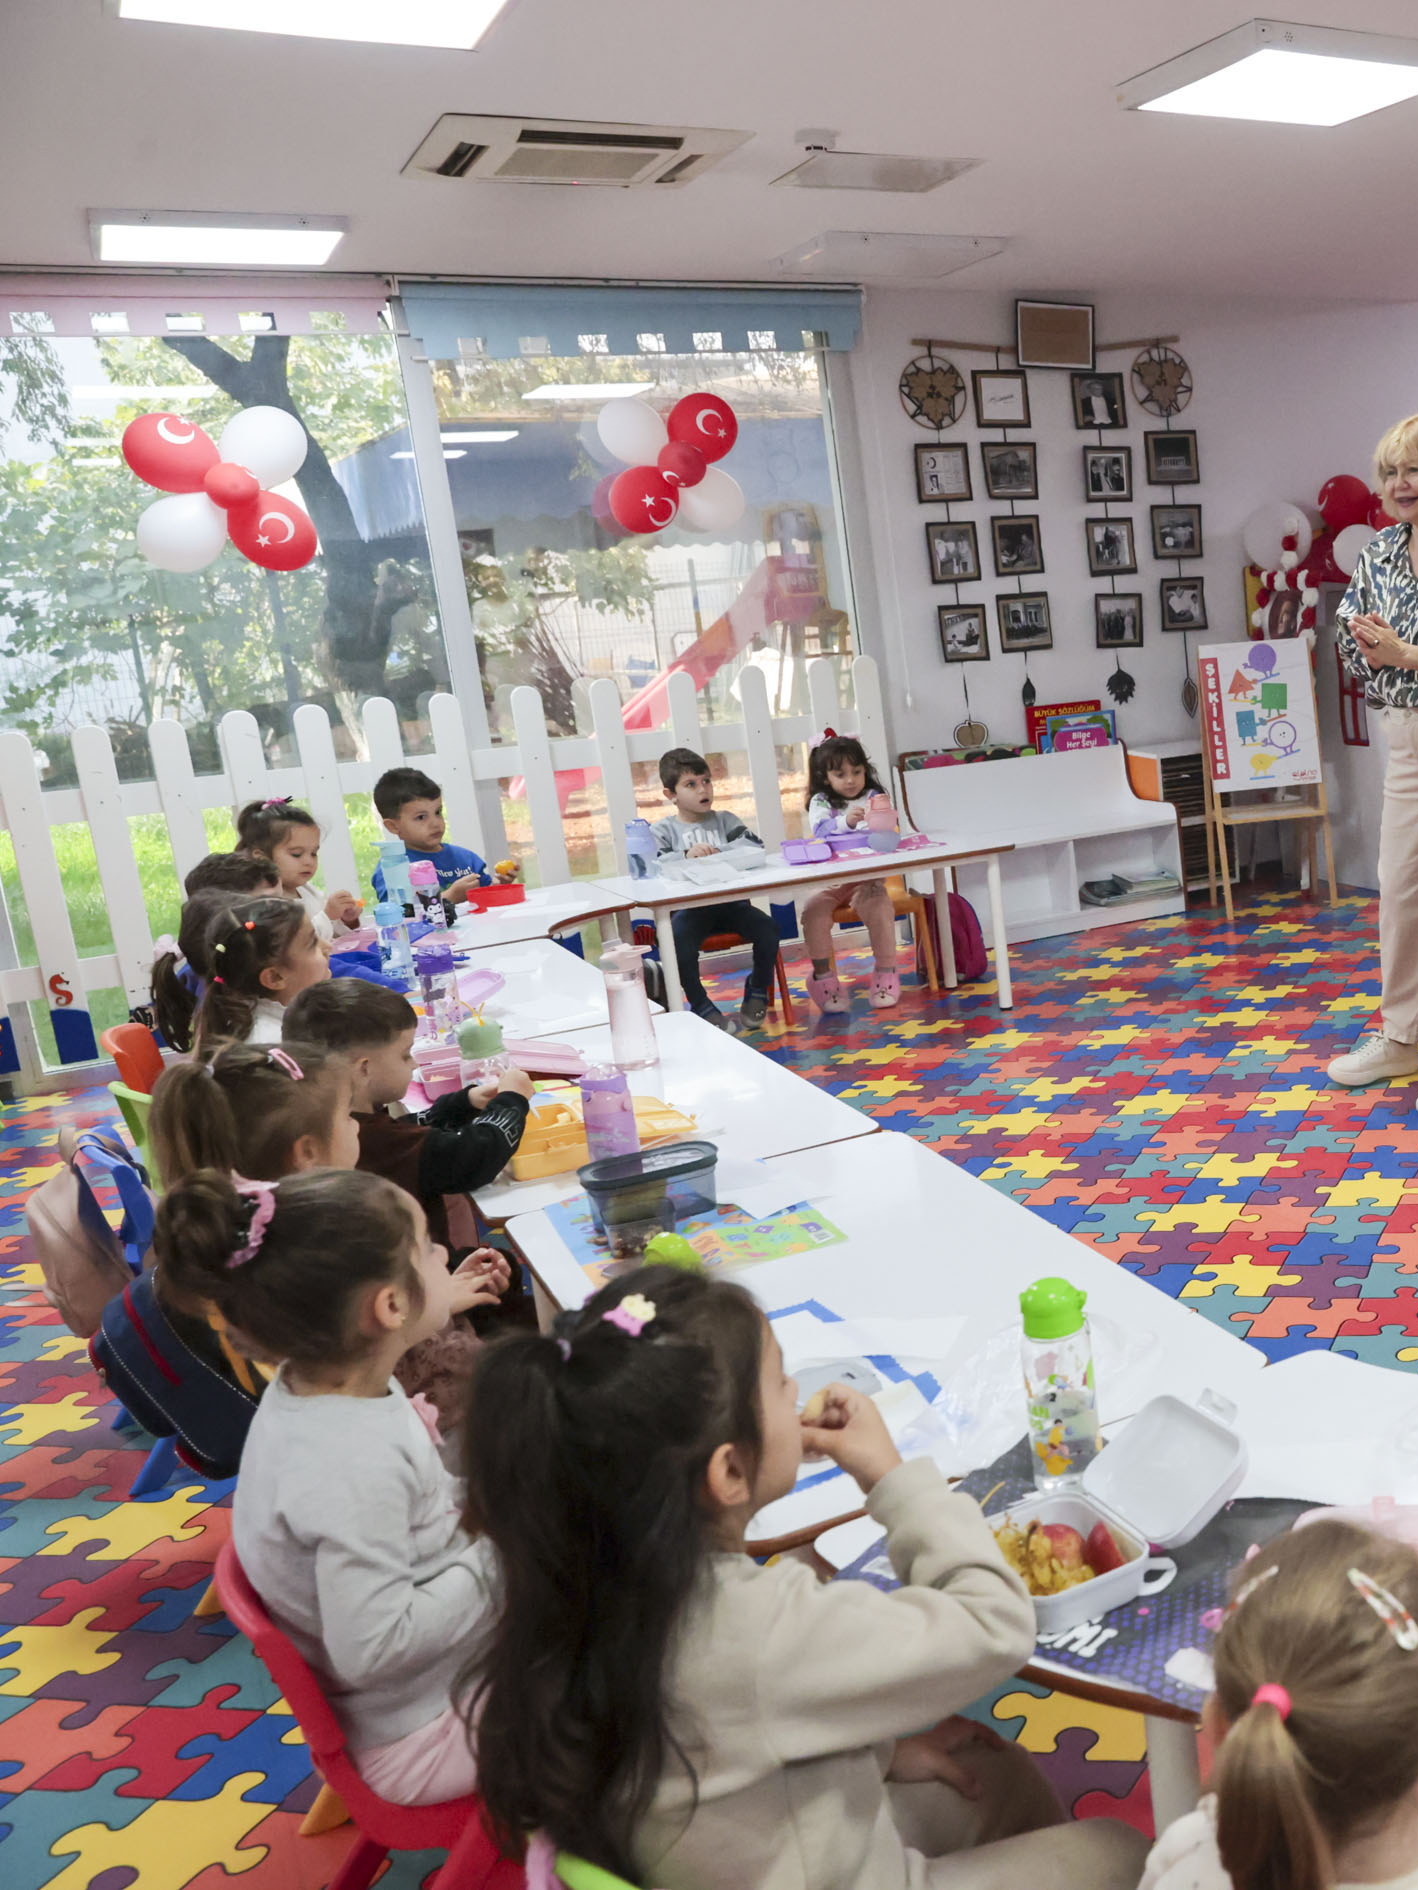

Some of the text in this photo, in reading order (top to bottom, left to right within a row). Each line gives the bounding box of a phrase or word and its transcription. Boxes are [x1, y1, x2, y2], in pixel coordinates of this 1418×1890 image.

[1034, 708, 1057, 718] BÜYÜK
[1205, 663, 1227, 775] ŞEKİLLER
[1072, 731, 1091, 741] Bilge
[1066, 741, 1080, 749] Her
[682, 829, 721, 850] RUN
